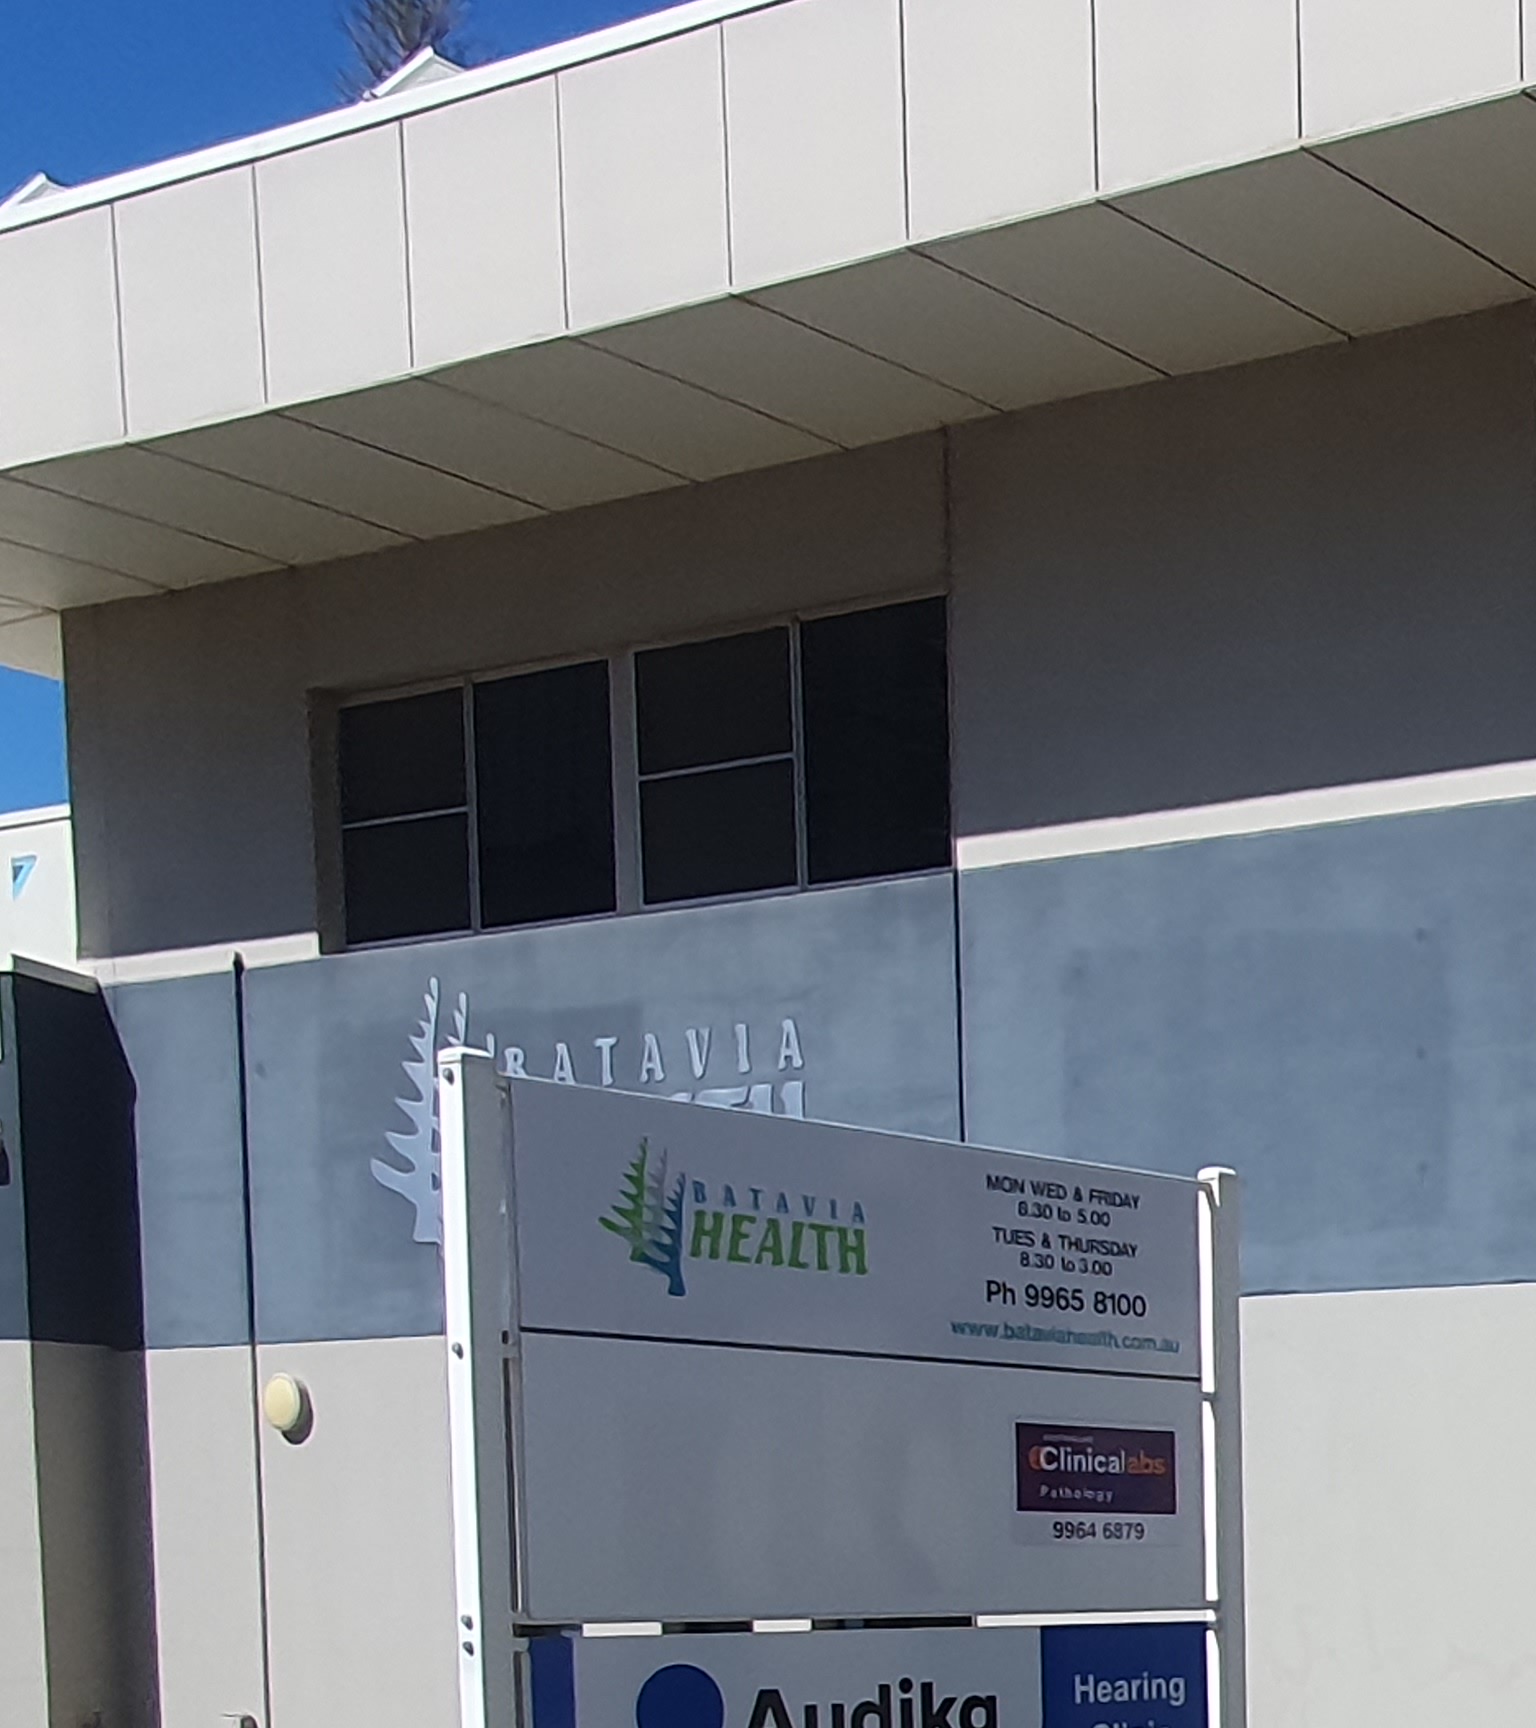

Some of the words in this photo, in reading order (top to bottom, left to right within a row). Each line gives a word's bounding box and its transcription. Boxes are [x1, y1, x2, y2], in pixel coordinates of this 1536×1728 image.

[503, 1018, 804, 1087] BATAVIA
[692, 1179, 866, 1225] BATAVIA
[986, 1173, 1025, 1195] MON
[1030, 1180, 1068, 1201] WED
[1073, 1186, 1083, 1203] &
[1088, 1188, 1141, 1210] FRIDAY
[1057, 1206, 1071, 1223] to
[1077, 1208, 1111, 1227] 5.00
[689, 1209, 868, 1276] HEALTH
[992, 1226, 1035, 1247] TUES
[1041, 1232, 1051, 1249] &
[1057, 1234, 1138, 1258] THURSDAY
[1020, 1251, 1055, 1270] 8.30
[1061, 1256, 1075, 1272] to
[1079, 1257, 1113, 1276] 3.00
[985, 1279, 1017, 1306] Ph
[1024, 1283, 1085, 1312] 9965
[1093, 1290, 1147, 1318] 8100
[1052, 1520, 1097, 1540] 9964
[1073, 1672, 1187, 1705] Hearing
